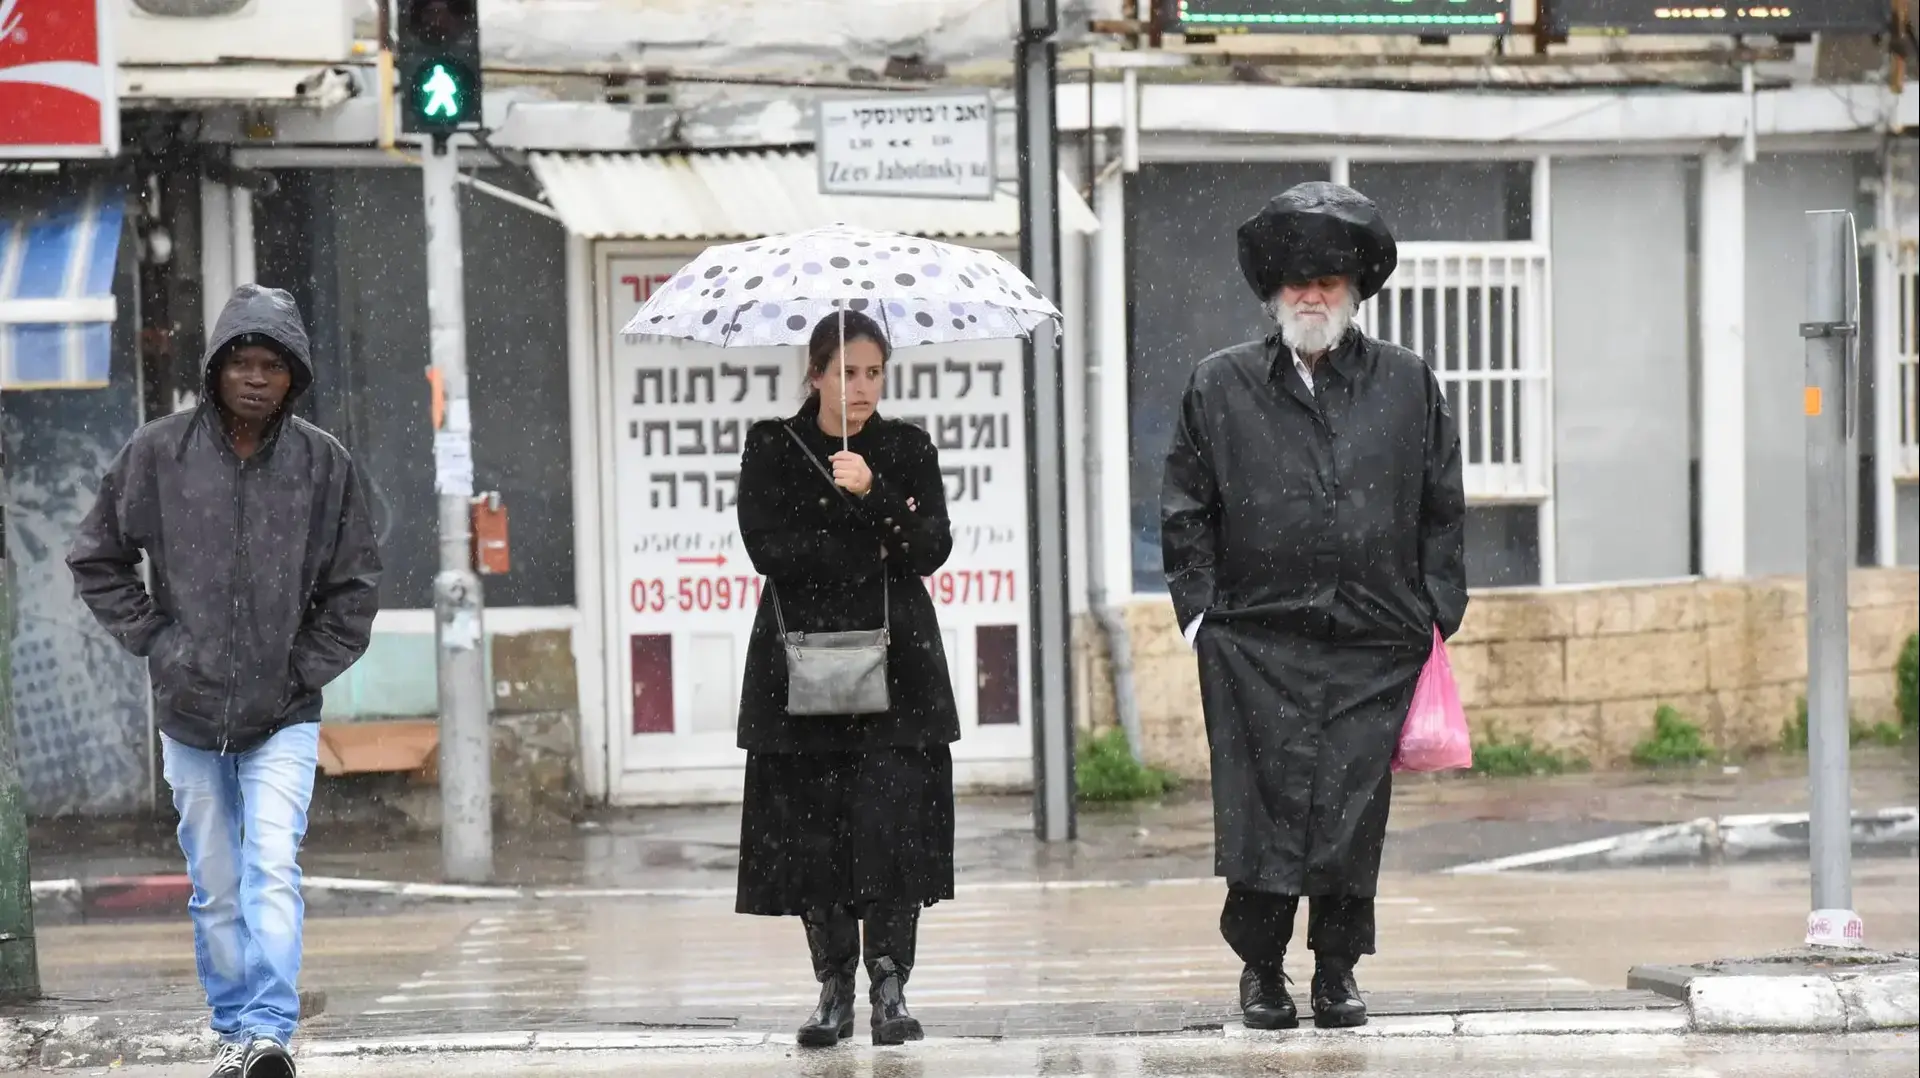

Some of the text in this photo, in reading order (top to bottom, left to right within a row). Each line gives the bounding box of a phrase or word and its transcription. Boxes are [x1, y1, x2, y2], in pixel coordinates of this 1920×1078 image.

[954, 103, 987, 122] זאב
[633, 362, 780, 404] דלתות
[629, 418, 757, 456] טבחי
